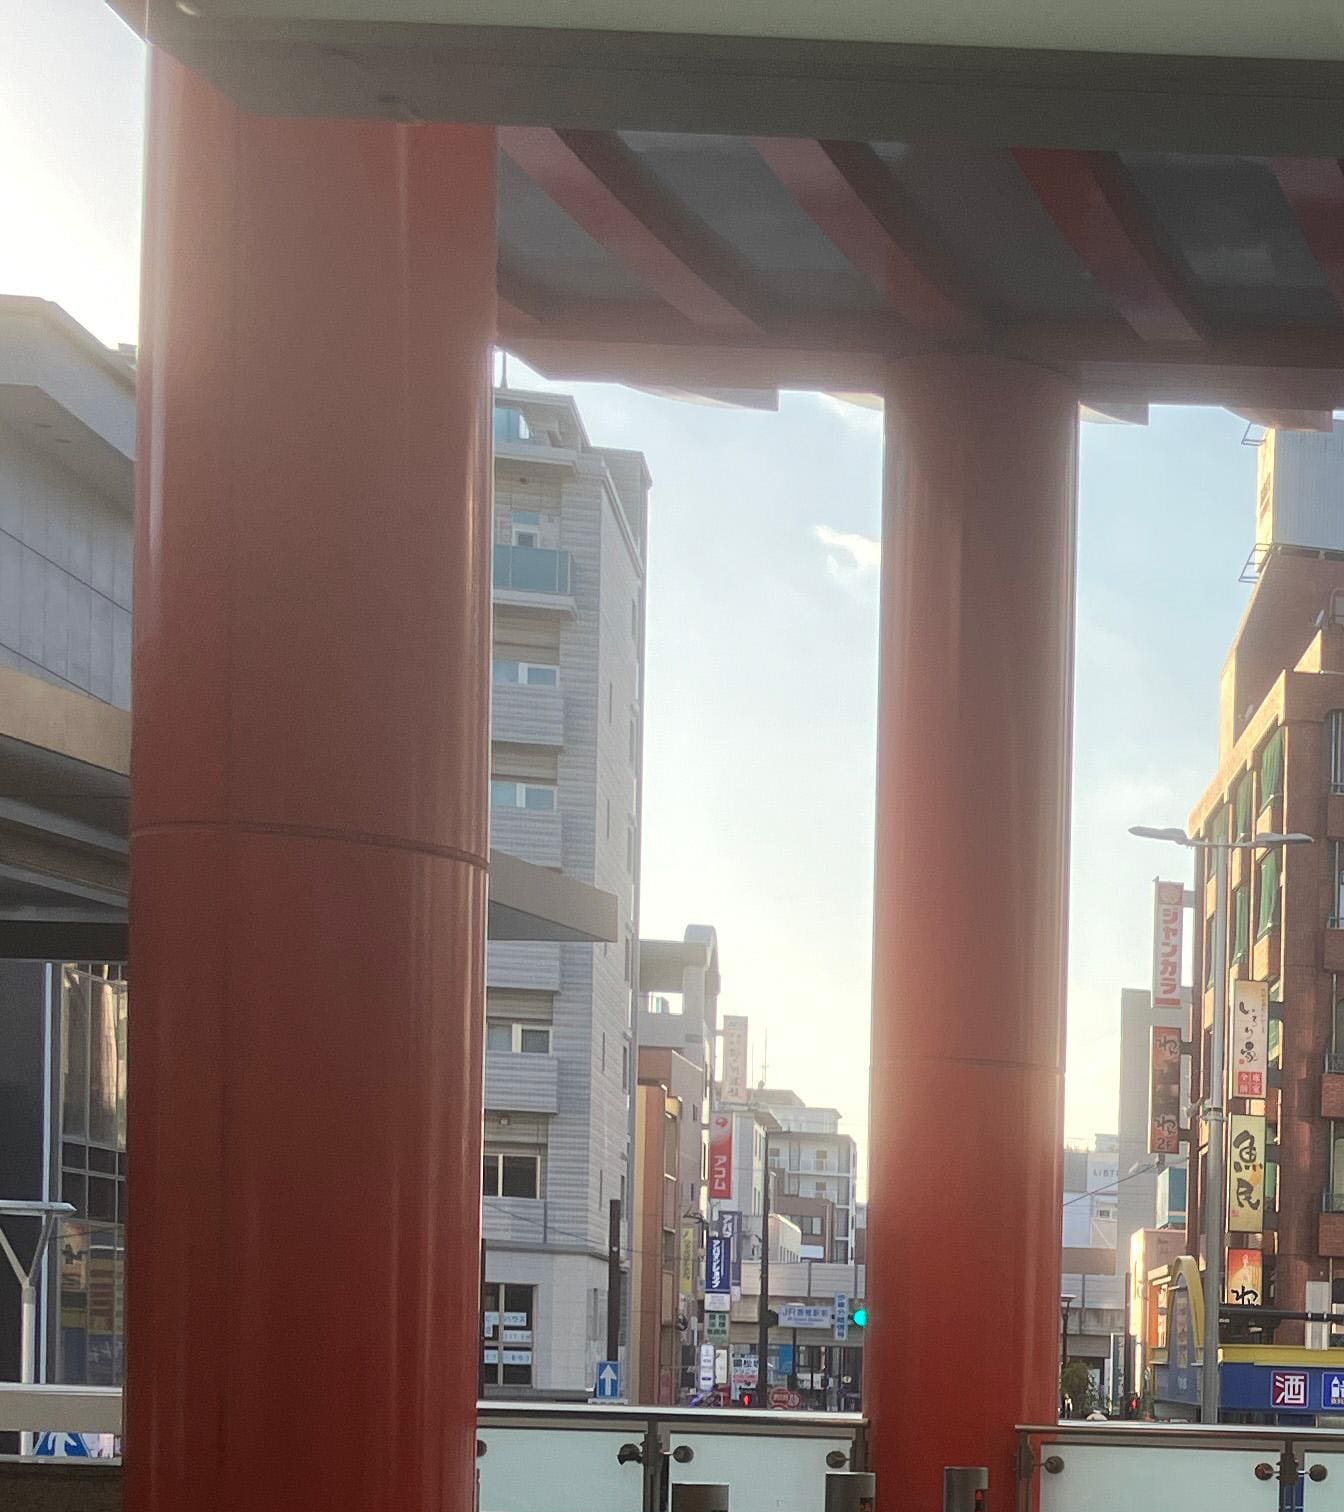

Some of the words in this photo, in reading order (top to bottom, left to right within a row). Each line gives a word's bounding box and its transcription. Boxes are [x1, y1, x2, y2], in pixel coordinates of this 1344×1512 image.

[1159, 907, 1178, 995] ジャンカラ
[713, 1154, 726, 1191] アコム
[1232, 1129, 1262, 1210] 魚民
[1274, 1375, 1306, 1406] 酒
